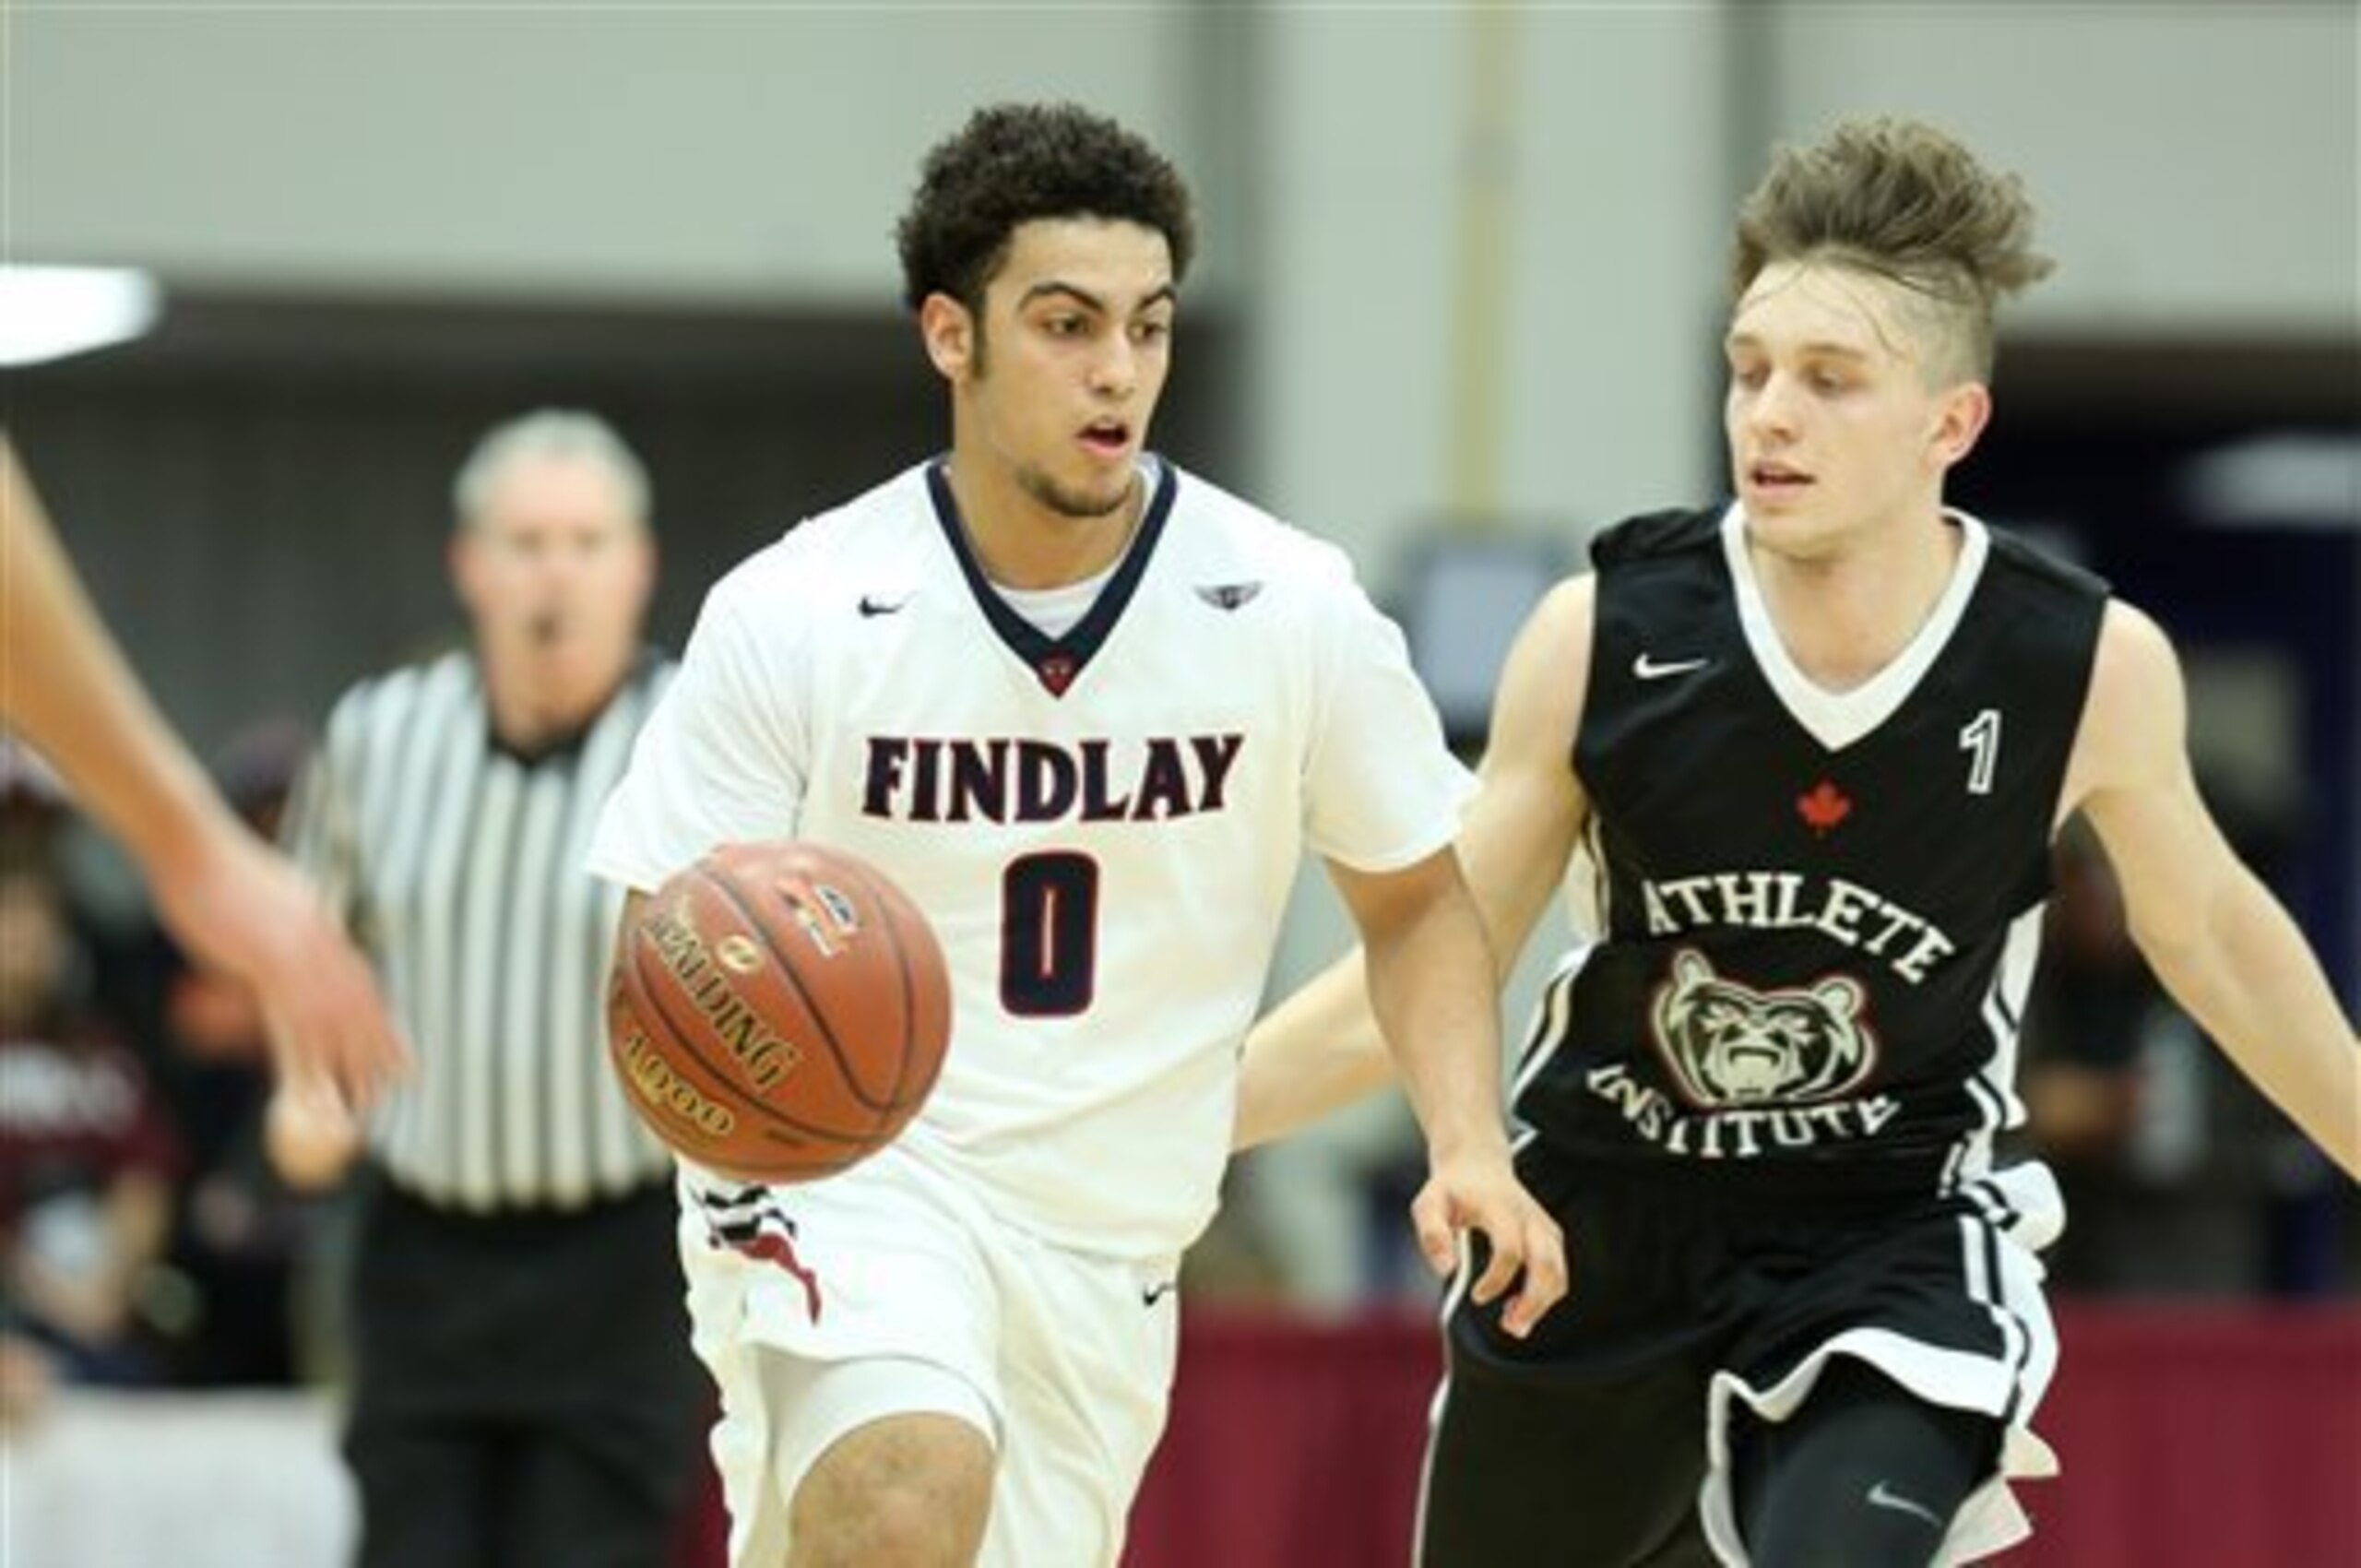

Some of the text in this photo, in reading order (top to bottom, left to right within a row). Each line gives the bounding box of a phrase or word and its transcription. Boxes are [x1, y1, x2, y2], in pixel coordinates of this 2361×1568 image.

[862, 733, 1245, 825] FINDLAY
[1959, 708, 2000, 793] 1
[1000, 849, 1098, 1017] 0
[1643, 872, 1954, 984] ATHLETE
[650, 915, 801, 1088] SPALDING
